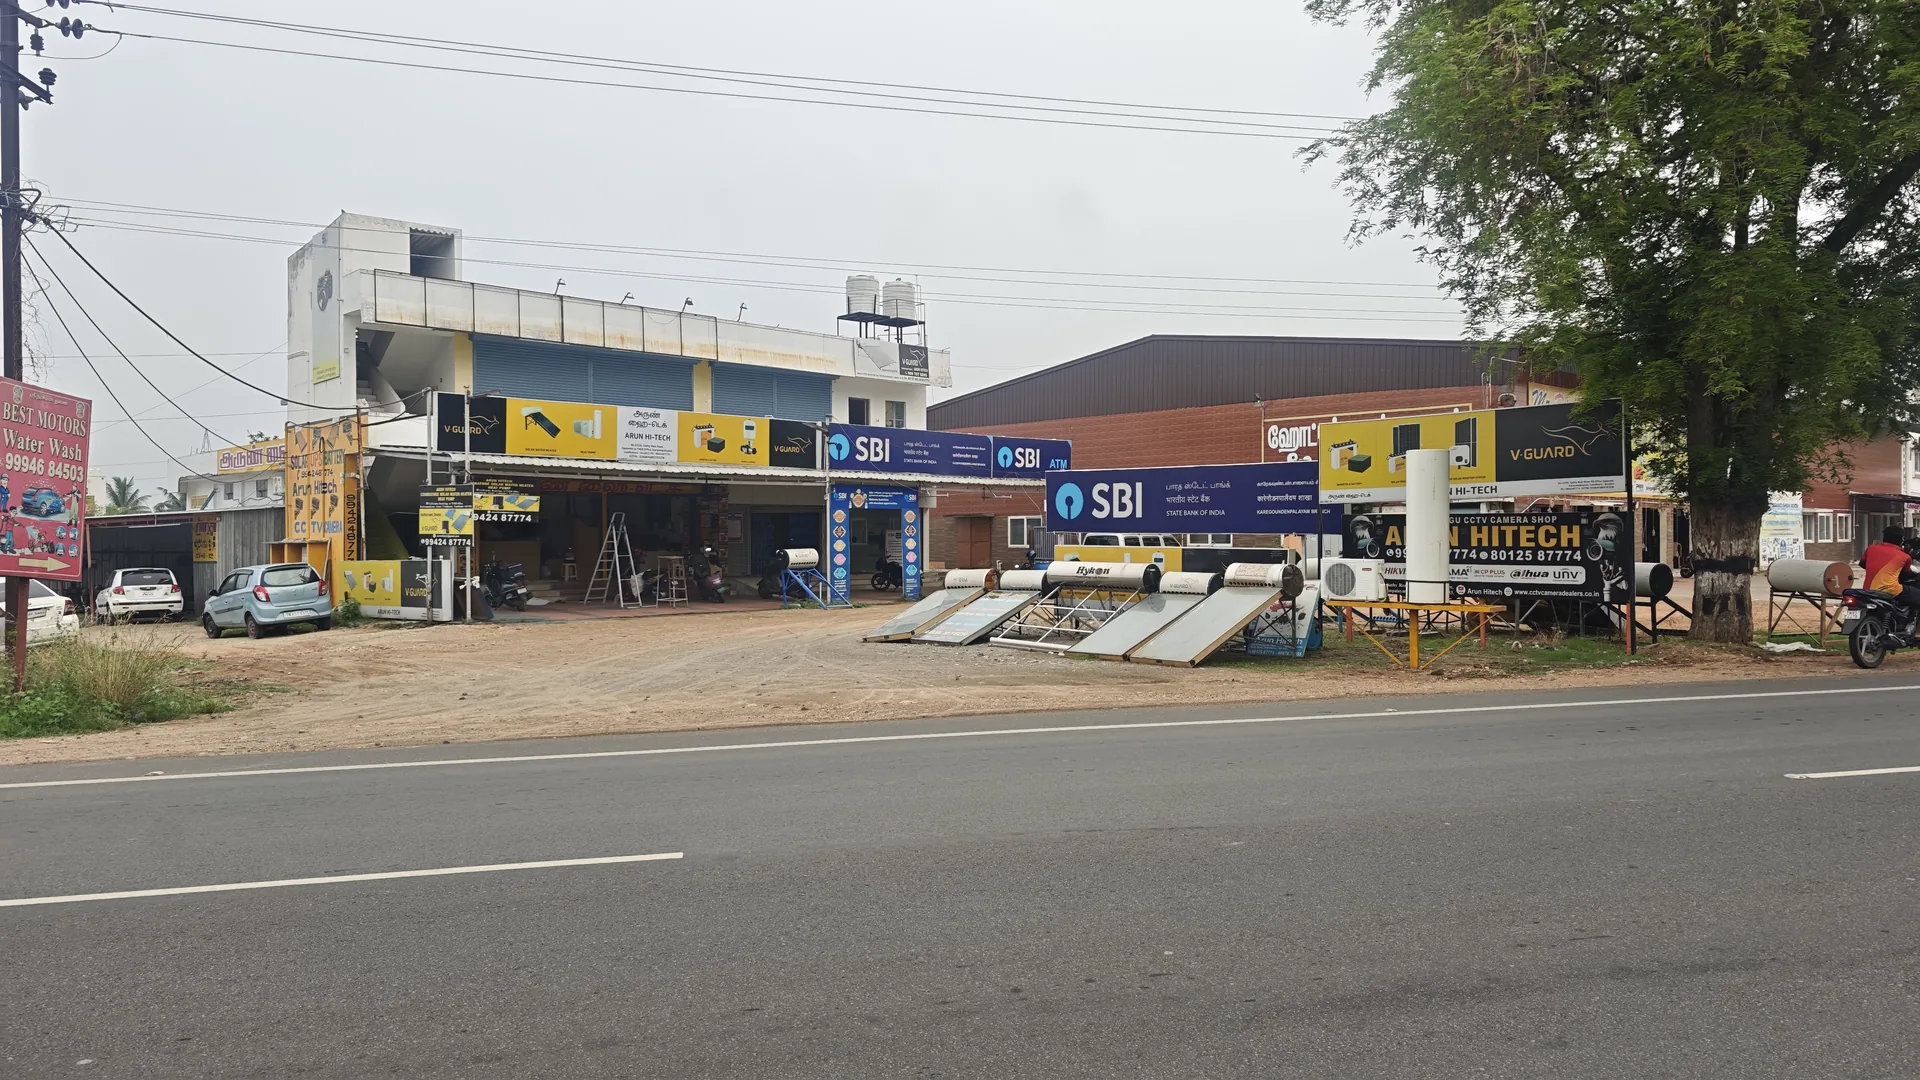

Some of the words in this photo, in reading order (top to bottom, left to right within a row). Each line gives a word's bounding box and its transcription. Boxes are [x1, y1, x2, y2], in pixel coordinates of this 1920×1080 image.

[3, 402, 34, 426] BEST
[37, 410, 86, 437] MOTORS
[444, 425, 482, 435] V-GURD
[3, 428, 44, 454] Water
[49, 438, 82, 461] Wash
[855, 436, 890, 463] SBI
[1014, 448, 1040, 468] SBI
[1510, 446, 1575, 461] V-GUARD
[6, 453, 44, 475] 99946
[48, 461, 84, 482] 84503
[1050, 457, 1068, 470] ATM
[292, 482, 311, 496] Arun
[1455, 485, 1498, 495] HI-TECH
[1091, 482, 1143, 519] SBI
[474, 513, 498, 521] 9424
[501, 514, 532, 522] 87774
[1200, 509, 1208, 517] OF
[1208, 509, 1226, 517] INDIA
[1463, 516, 1487, 524] CCTV
[1490, 516, 1529, 524] CAMERA
[1531, 515, 1557, 523] SHOP
[346, 494, 356, 560] 99424877
[425, 538, 447, 546] 99424
[448, 538, 471, 546] 87774
[1470, 524, 1580, 548] HITECH
[1490, 550, 1533, 561] 80125
[1537, 550, 1582, 561] 87774
[404, 587, 428, 597] V-GUARD
[1483, 588, 1503, 596] Hitech
[1514, 589, 1600, 597] www.cctvcameradealers.co.in
